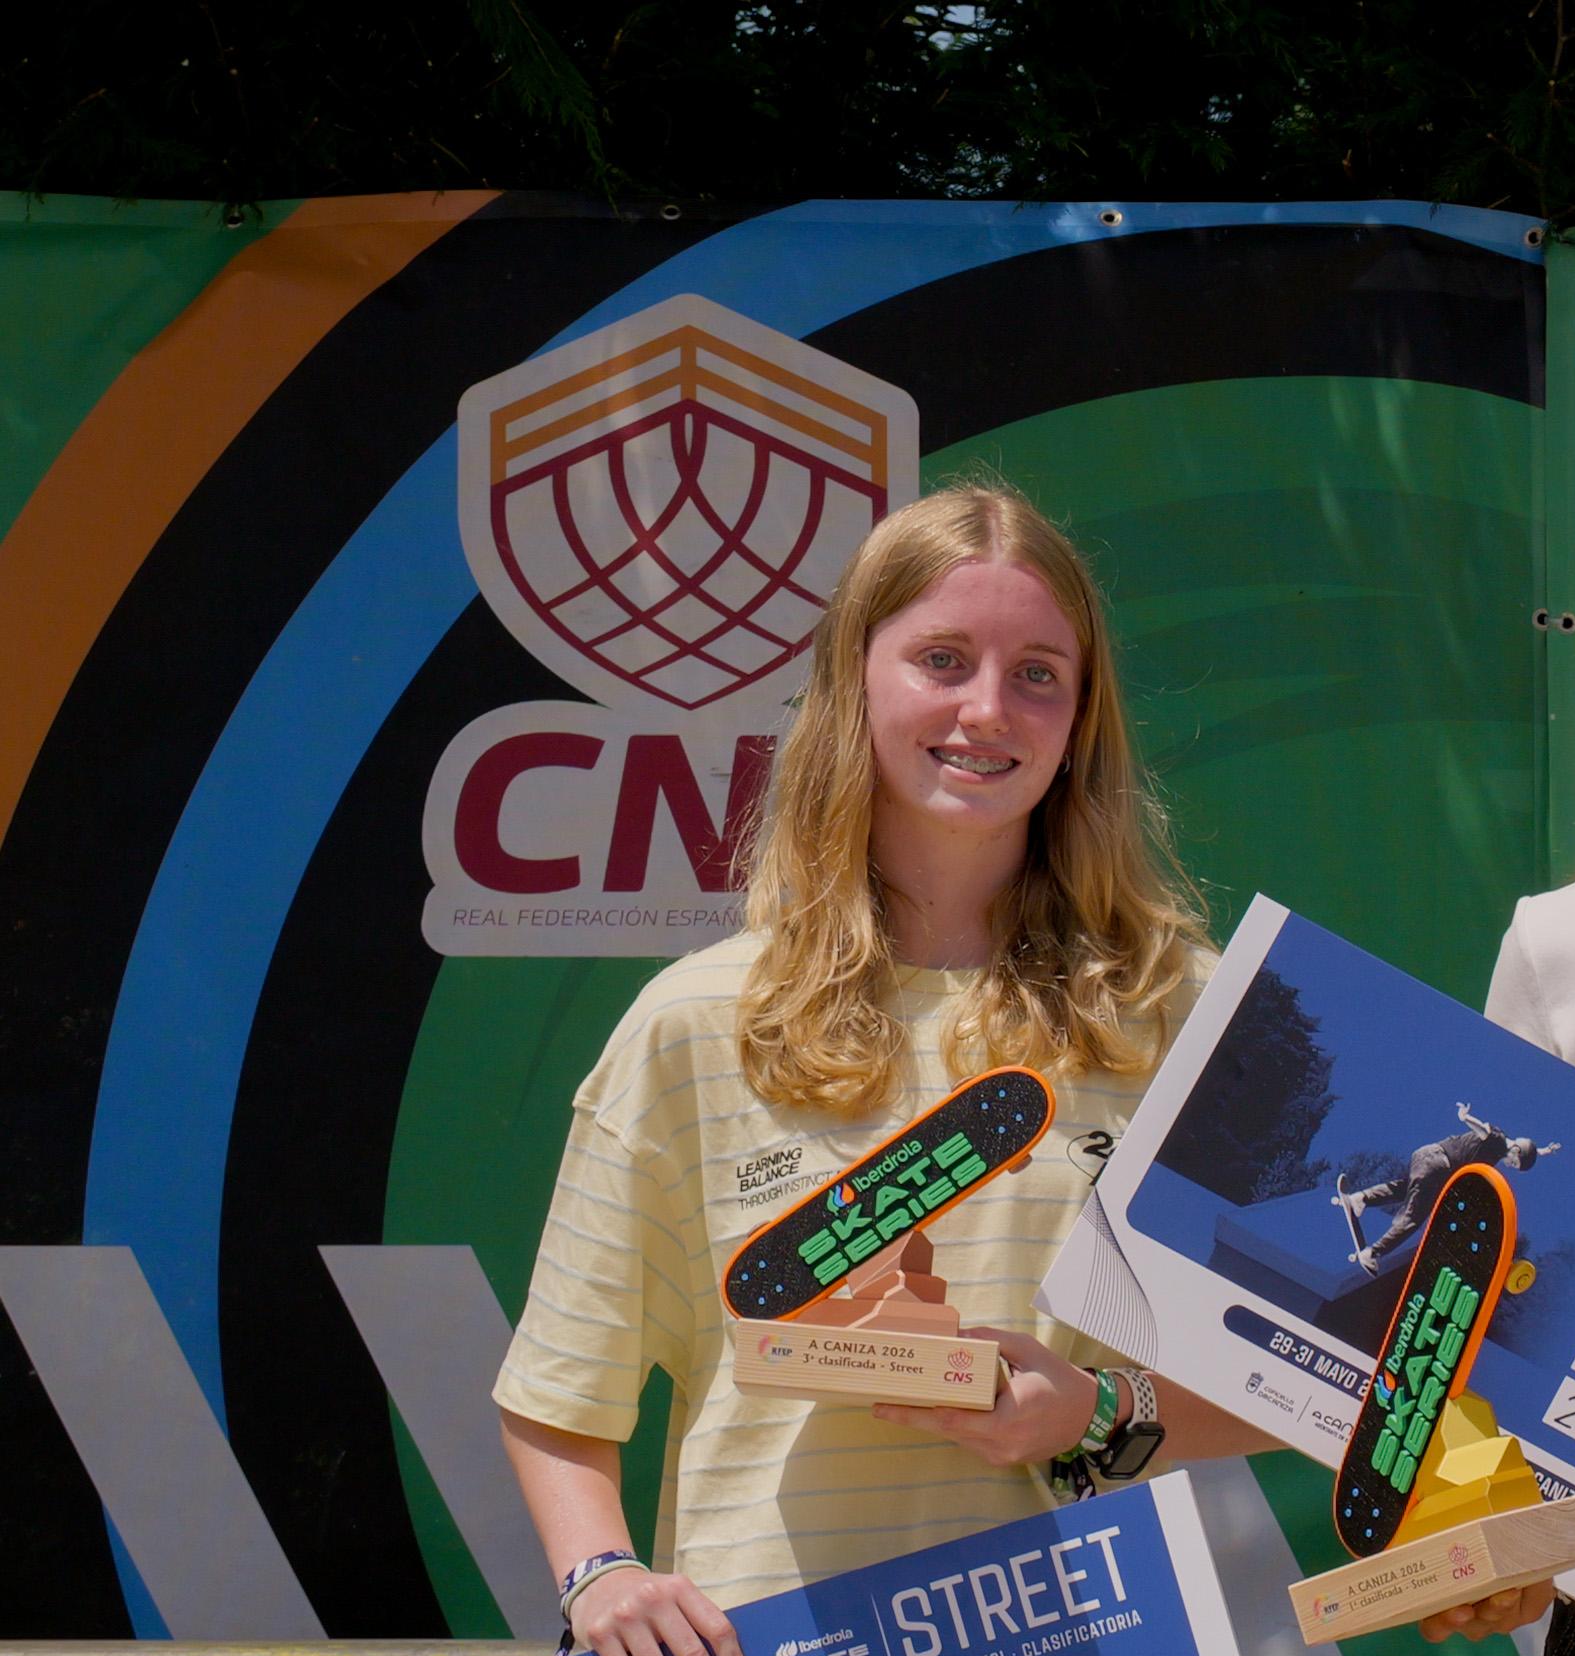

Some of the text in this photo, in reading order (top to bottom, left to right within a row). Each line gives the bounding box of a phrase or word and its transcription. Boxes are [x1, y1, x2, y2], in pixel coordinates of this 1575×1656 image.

[454, 732, 776, 894] CN
[453, 906, 747, 926] REAL FEDERACIÓN ESPAÑ
[737, 1147, 802, 1178] LEARNING
[740, 1161, 800, 1192] BALANCE
[852, 1140, 922, 1192] Iberdrola
[738, 1184, 783, 1210] THROUGH
[798, 1132, 973, 1265] SKATE
[813, 1153, 987, 1286] SERIES
[808, 1339, 915, 1359] A CANIZA 2026
[1385, 1293, 1426, 1374] Iberdrola
[818, 1355, 876, 1370] clasificada
[889, 1361, 924, 1375] Street
[1269, 1331, 1315, 1366] 29-31
[1313, 1355, 1358, 1389] MAYO
[1371, 1266, 1462, 1477] SKATE
[943, 1371, 974, 1384] CNS
[1390, 1284, 1479, 1494] SERIES
[1348, 1561, 1427, 1596] A CANIZA 2026
[1452, 1564, 1476, 1580] CNS
[1360, 1583, 1403, 1607] clasificada
[798, 1628, 854, 1653] Iberdrola
